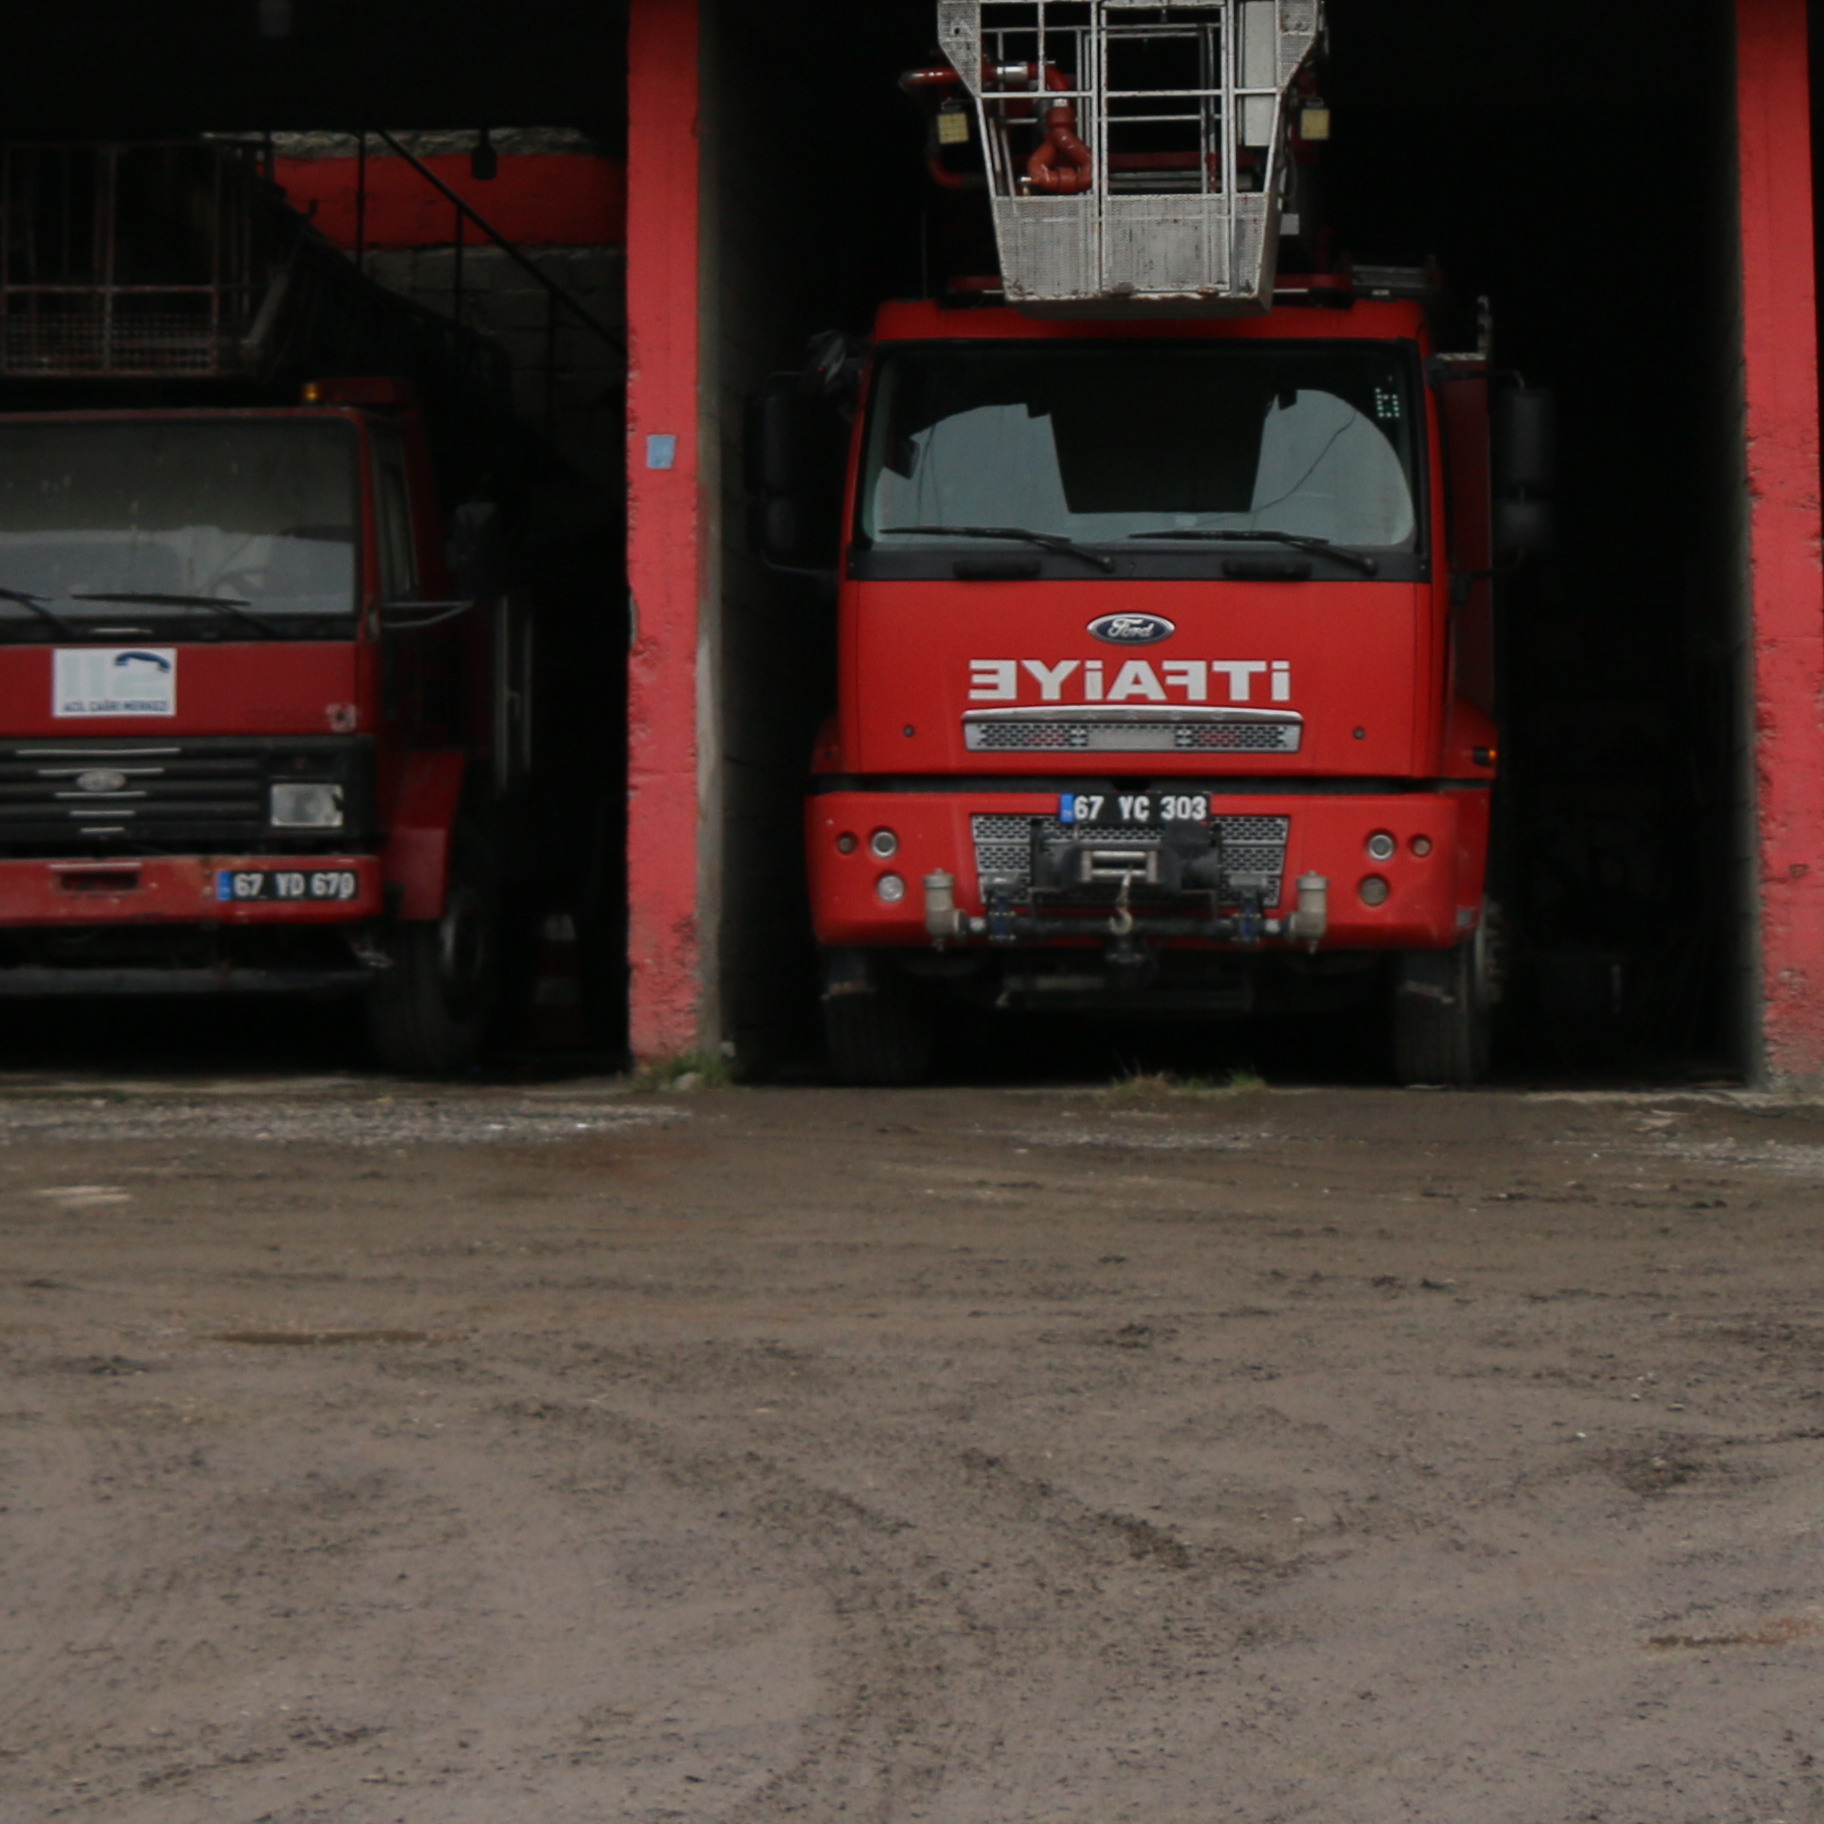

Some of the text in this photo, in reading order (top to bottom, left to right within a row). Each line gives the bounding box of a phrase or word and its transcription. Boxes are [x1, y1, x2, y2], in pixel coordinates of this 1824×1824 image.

[1107, 617, 1155, 638] Ford
[1074, 795, 1207, 822] 67 YC 303
[234, 872, 264, 897] 67
